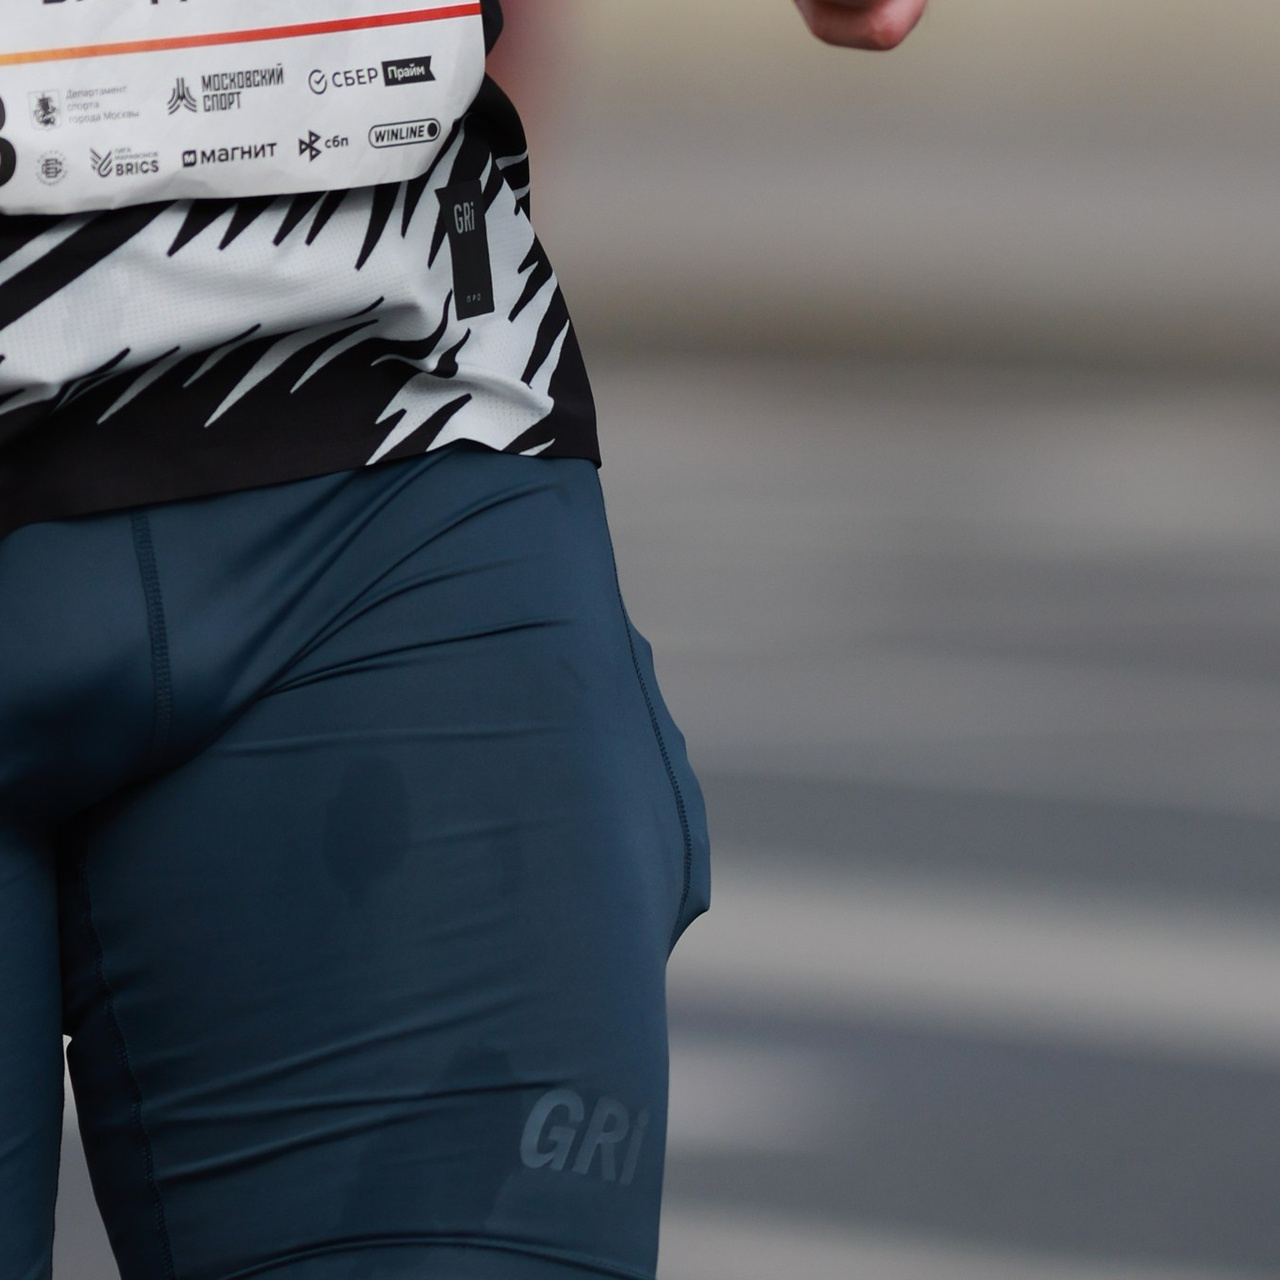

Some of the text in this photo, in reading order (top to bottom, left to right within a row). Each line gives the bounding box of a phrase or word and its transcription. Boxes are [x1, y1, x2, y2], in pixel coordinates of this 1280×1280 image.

[201, 62, 284, 92] МОСКОВСКИЙ
[332, 63, 425, 88] СБЕР Прайм
[203, 91, 242, 113] СПОРТ
[324, 134, 349, 149] сбп
[374, 124, 426, 144] WINLINE
[115, 159, 159, 176] BRICS
[453, 201, 475, 234] GRi
